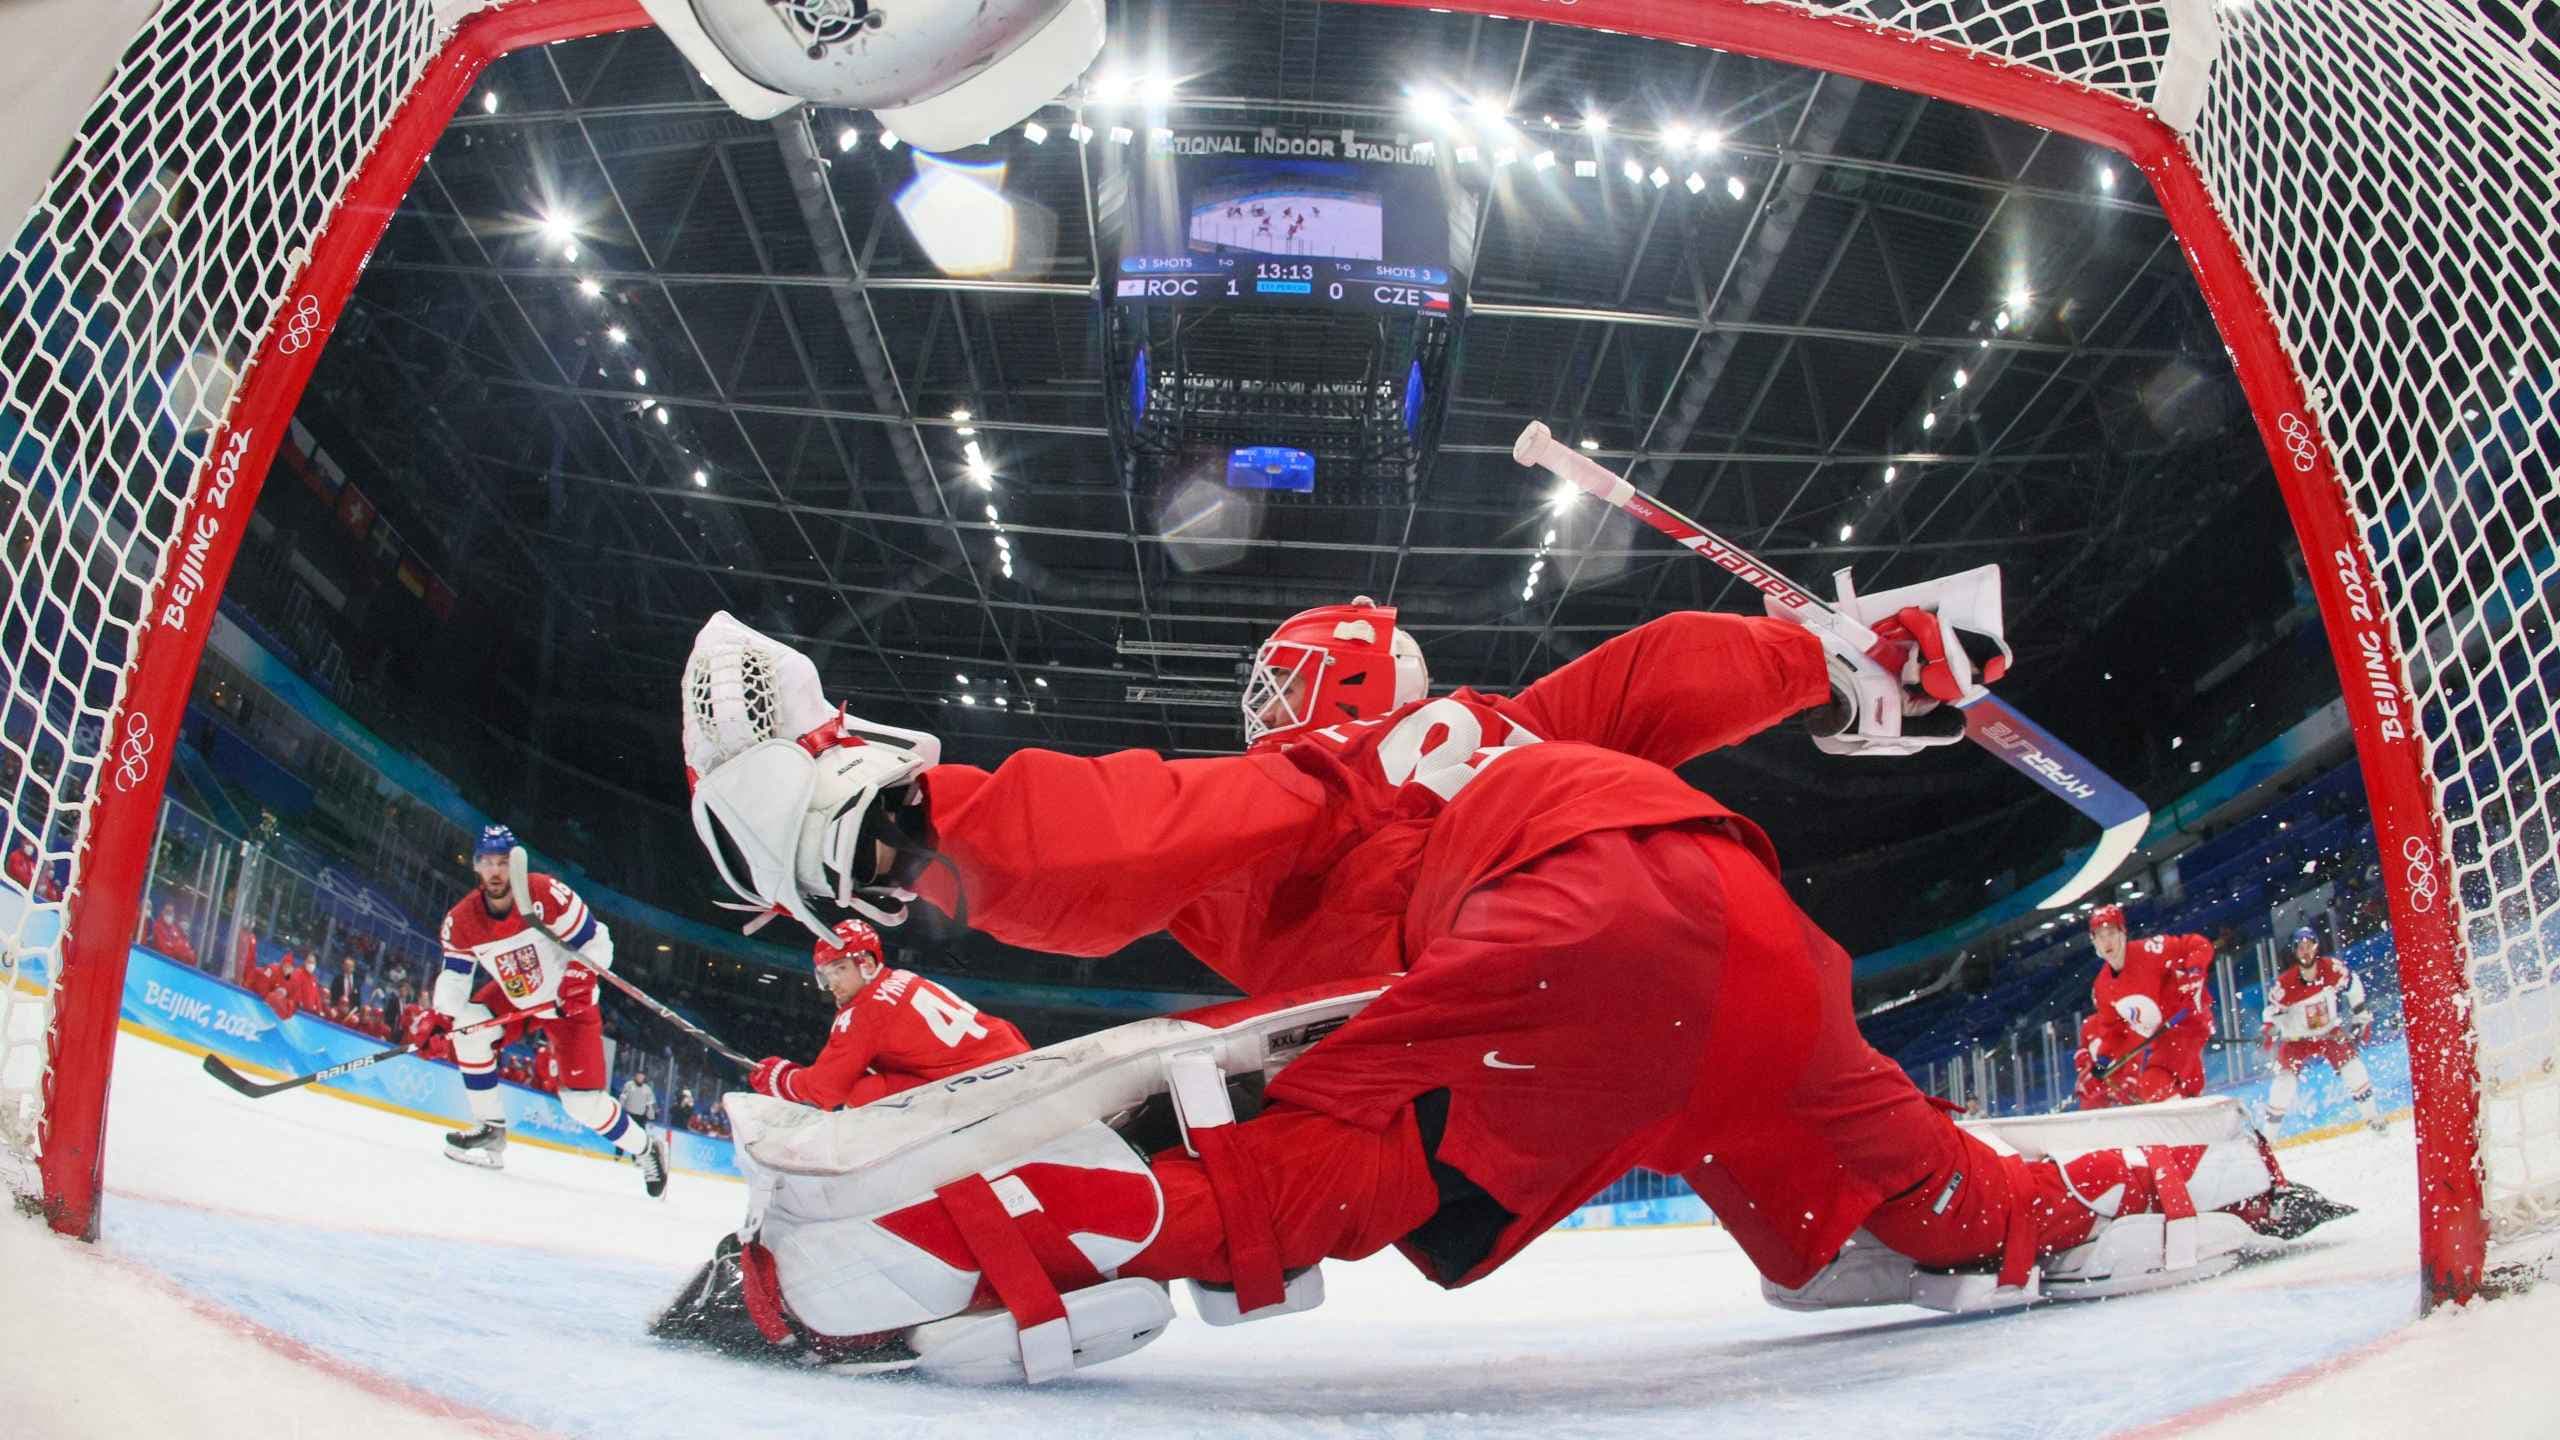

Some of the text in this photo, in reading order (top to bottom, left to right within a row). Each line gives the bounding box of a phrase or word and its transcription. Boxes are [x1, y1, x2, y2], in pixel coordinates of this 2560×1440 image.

[1168, 136, 1436, 167] TIONAL INDOOR STADIUM
[1138, 257, 1193, 270] 3 SHOTS
[1257, 263, 1313, 280] 13:13
[1376, 265, 1432, 281] SHOTS 3
[1148, 279, 1198, 296] ROC
[1226, 279, 1239, 296] 1
[1329, 282, 1343, 300] 0
[1374, 286, 1420, 307] CZE
[161, 427, 253, 631] BEIJING 2022
[1695, 539, 1809, 609] BAUER
[2335, 541, 2405, 743] BEIJING 2022
[1981, 721, 2096, 798] HYPERLITE
[143, 980, 266, 1042] BEIJING 2022
